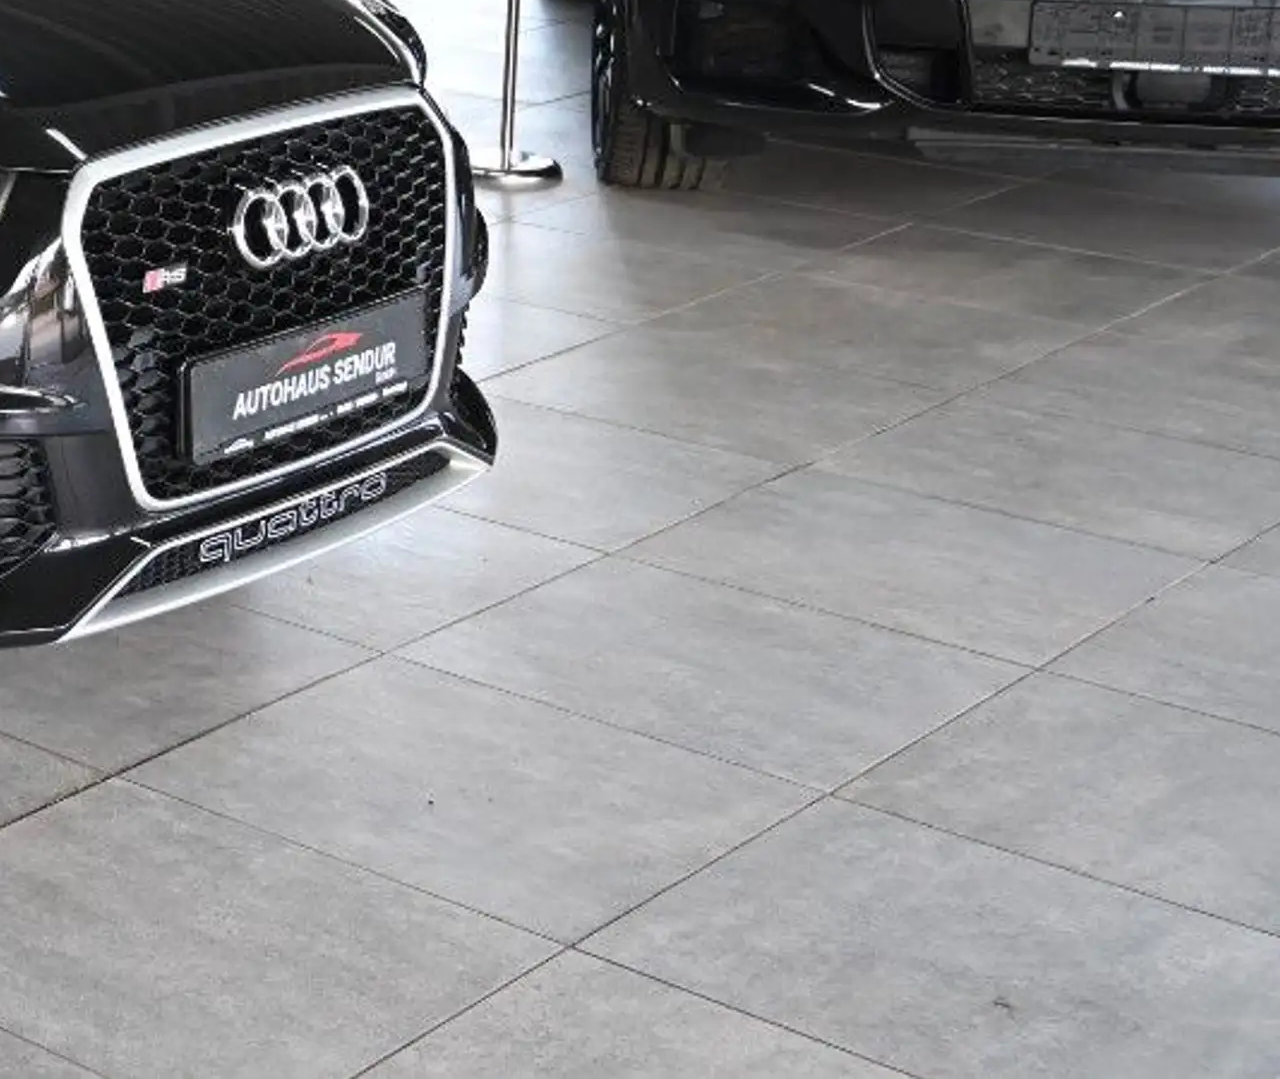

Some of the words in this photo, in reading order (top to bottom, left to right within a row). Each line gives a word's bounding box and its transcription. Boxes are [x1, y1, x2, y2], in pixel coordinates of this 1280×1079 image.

[232, 370, 332, 421] AUTOHAUS
[332, 342, 396, 385] SENDUR
[199, 472, 388, 563] quattro
